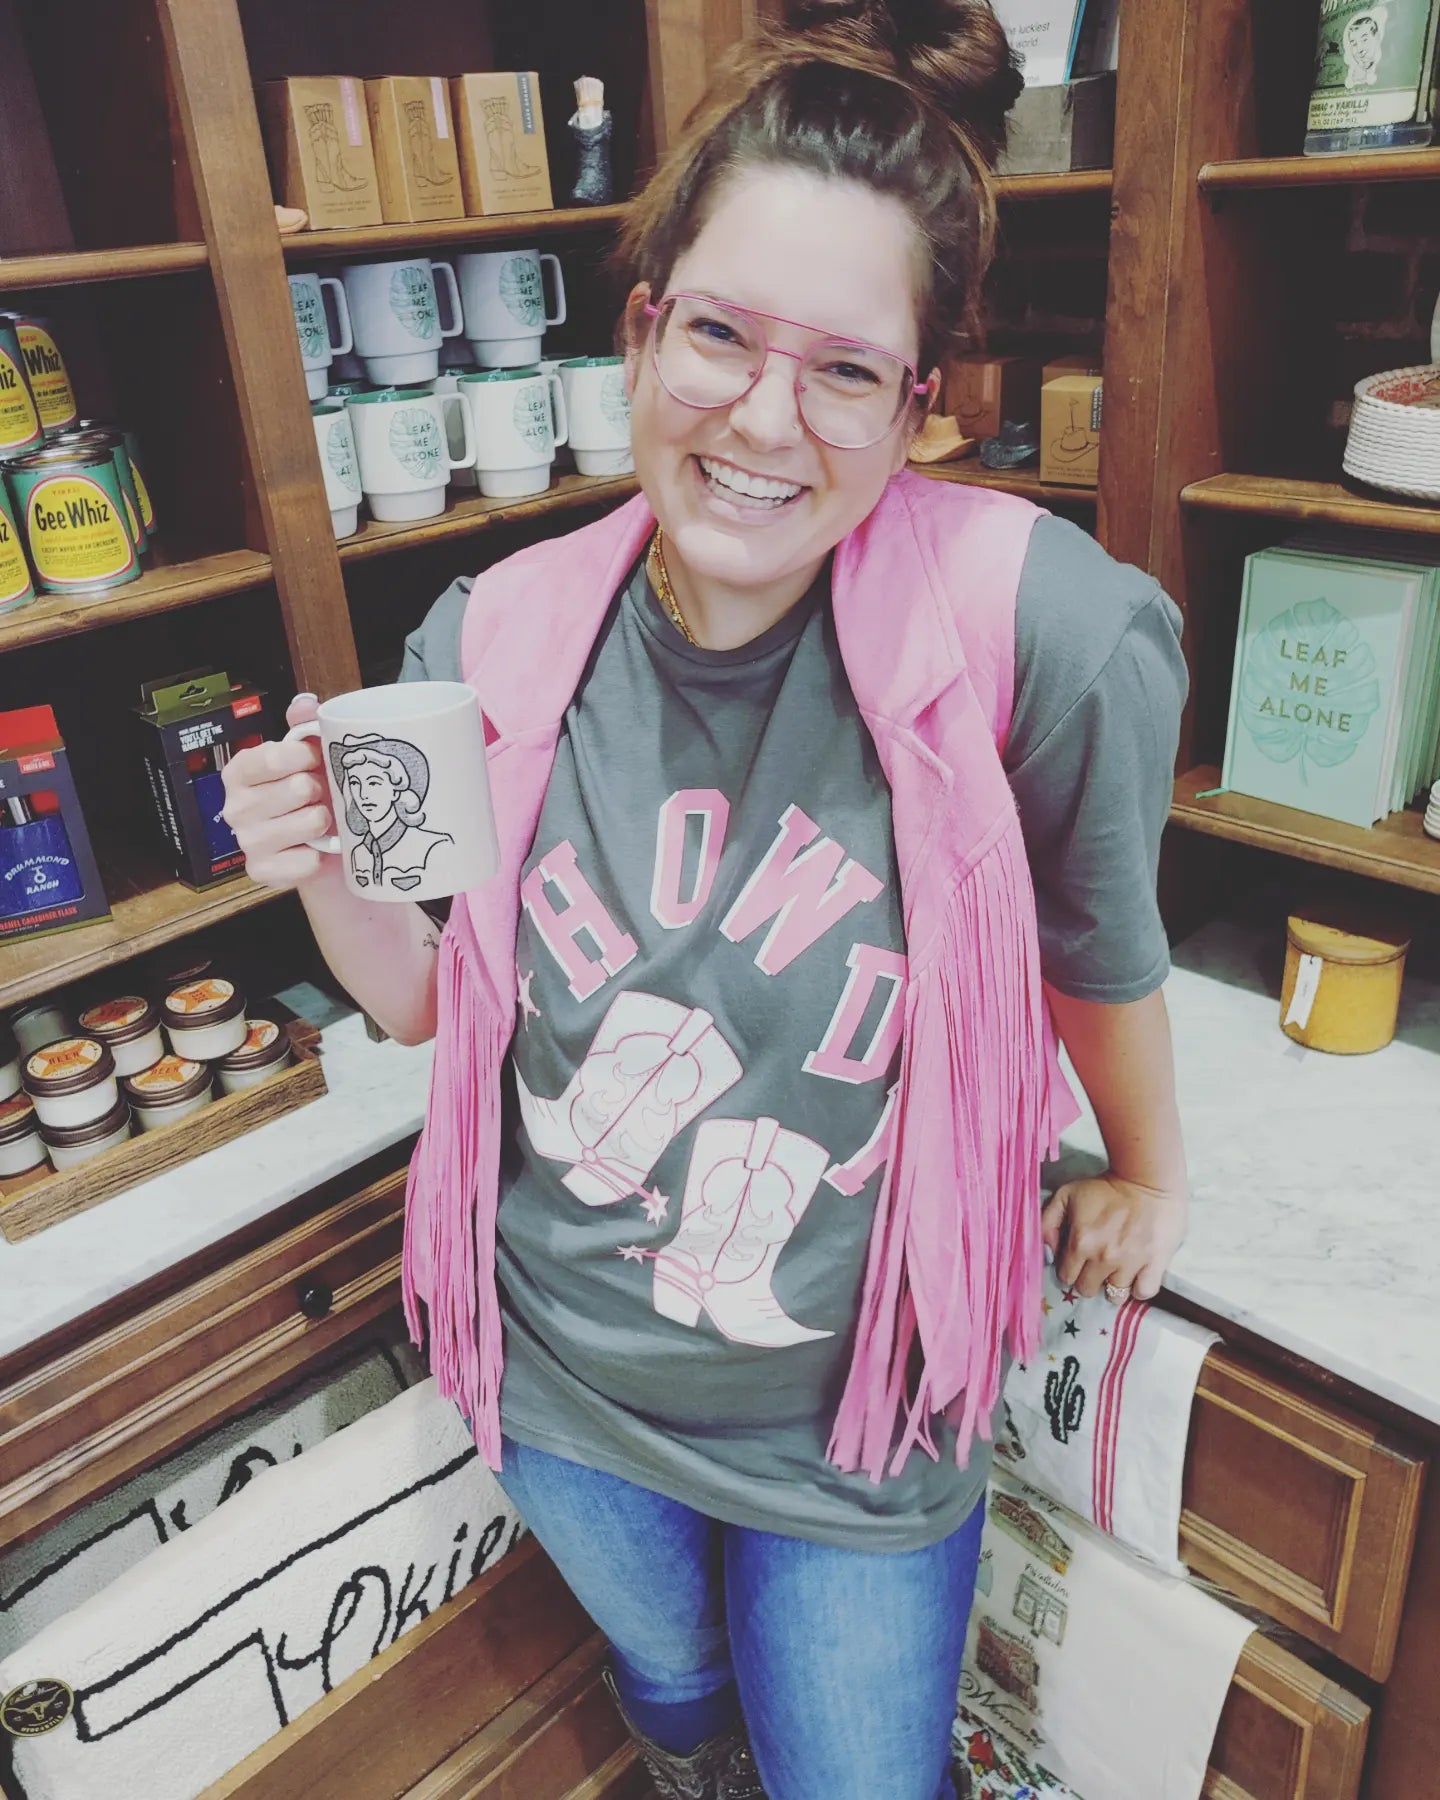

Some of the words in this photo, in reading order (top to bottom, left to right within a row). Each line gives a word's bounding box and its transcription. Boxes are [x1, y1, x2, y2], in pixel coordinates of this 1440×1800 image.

[35, 502, 67, 532] Gee
[64, 497, 110, 528] Whiz
[1280, 639, 1347, 668] LEAF
[1289, 671, 1328, 696] ME
[1259, 696, 1352, 732] ALONE
[5, 856, 70, 881] DRUMMOND
[26, 879, 59, 895] RANCH
